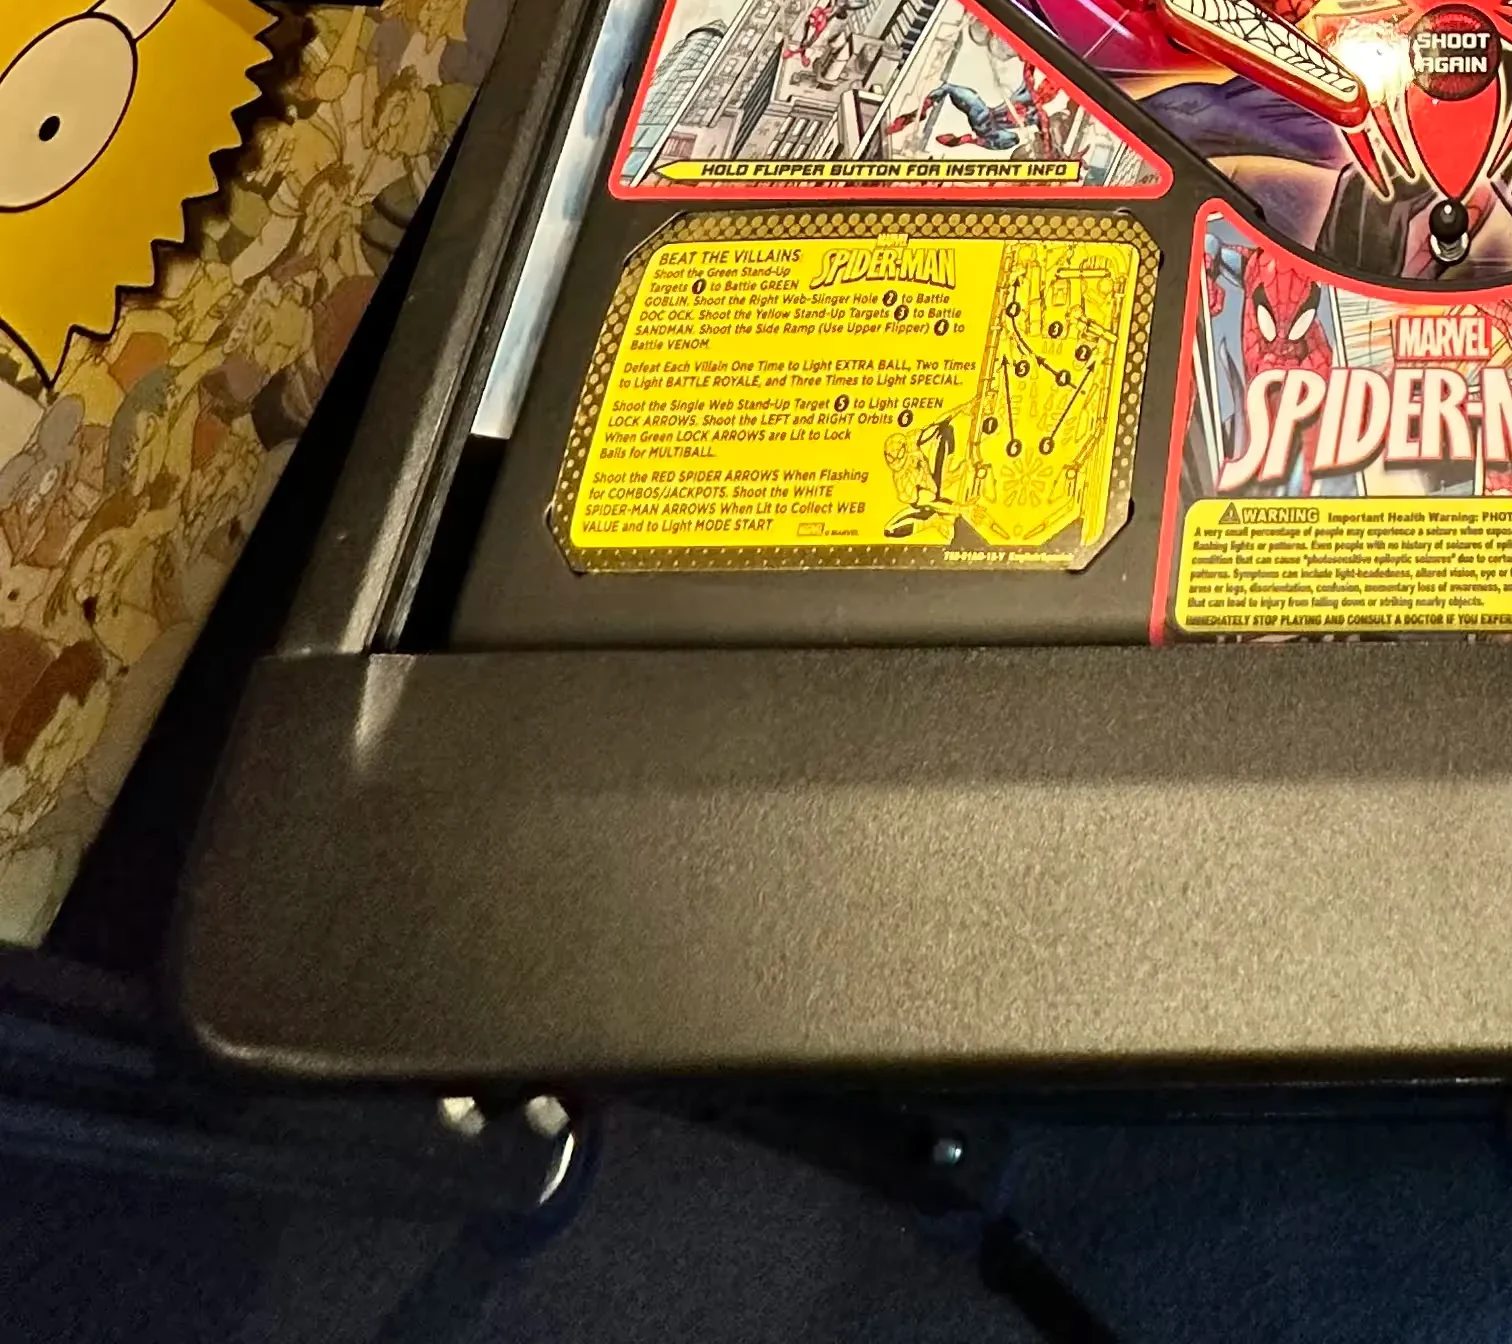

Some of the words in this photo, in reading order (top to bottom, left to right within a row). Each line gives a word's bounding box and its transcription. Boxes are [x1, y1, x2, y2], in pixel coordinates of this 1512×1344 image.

[1417, 32, 1490, 50] SHOOT
[1416, 56, 1487, 73] AGAIN
[702, 163, 749, 177] HOLD
[752, 163, 826, 177] FLIPPER
[831, 162, 902, 177] BUTTON
[907, 162, 942, 177] FOR
[946, 162, 1021, 177] INSTANT
[1027, 162, 1066, 176] INFO
[660, 251, 697, 265] BEAT
[702, 250, 730, 264] THE
[735, 249, 801, 263] VILLAINS
[654, 269, 684, 279] Shoot
[687, 269, 704, 279] the
[707, 268, 737, 278] Green
[741, 267, 790, 279] Stand-Up
[809, 248, 956, 290] SPIDER-MAN
[1399, 319, 1490, 358] MARVEL
[651, 471, 675, 483] RED
[678, 470, 722, 482] SPIDER
[725, 469, 779, 482] ARROWS
[1242, 508, 1318, 523] WARNING
[1328, 512, 1384, 523] Important
[1388, 512, 1425, 522] Health
[1429, 512, 1478, 523] Warning:
